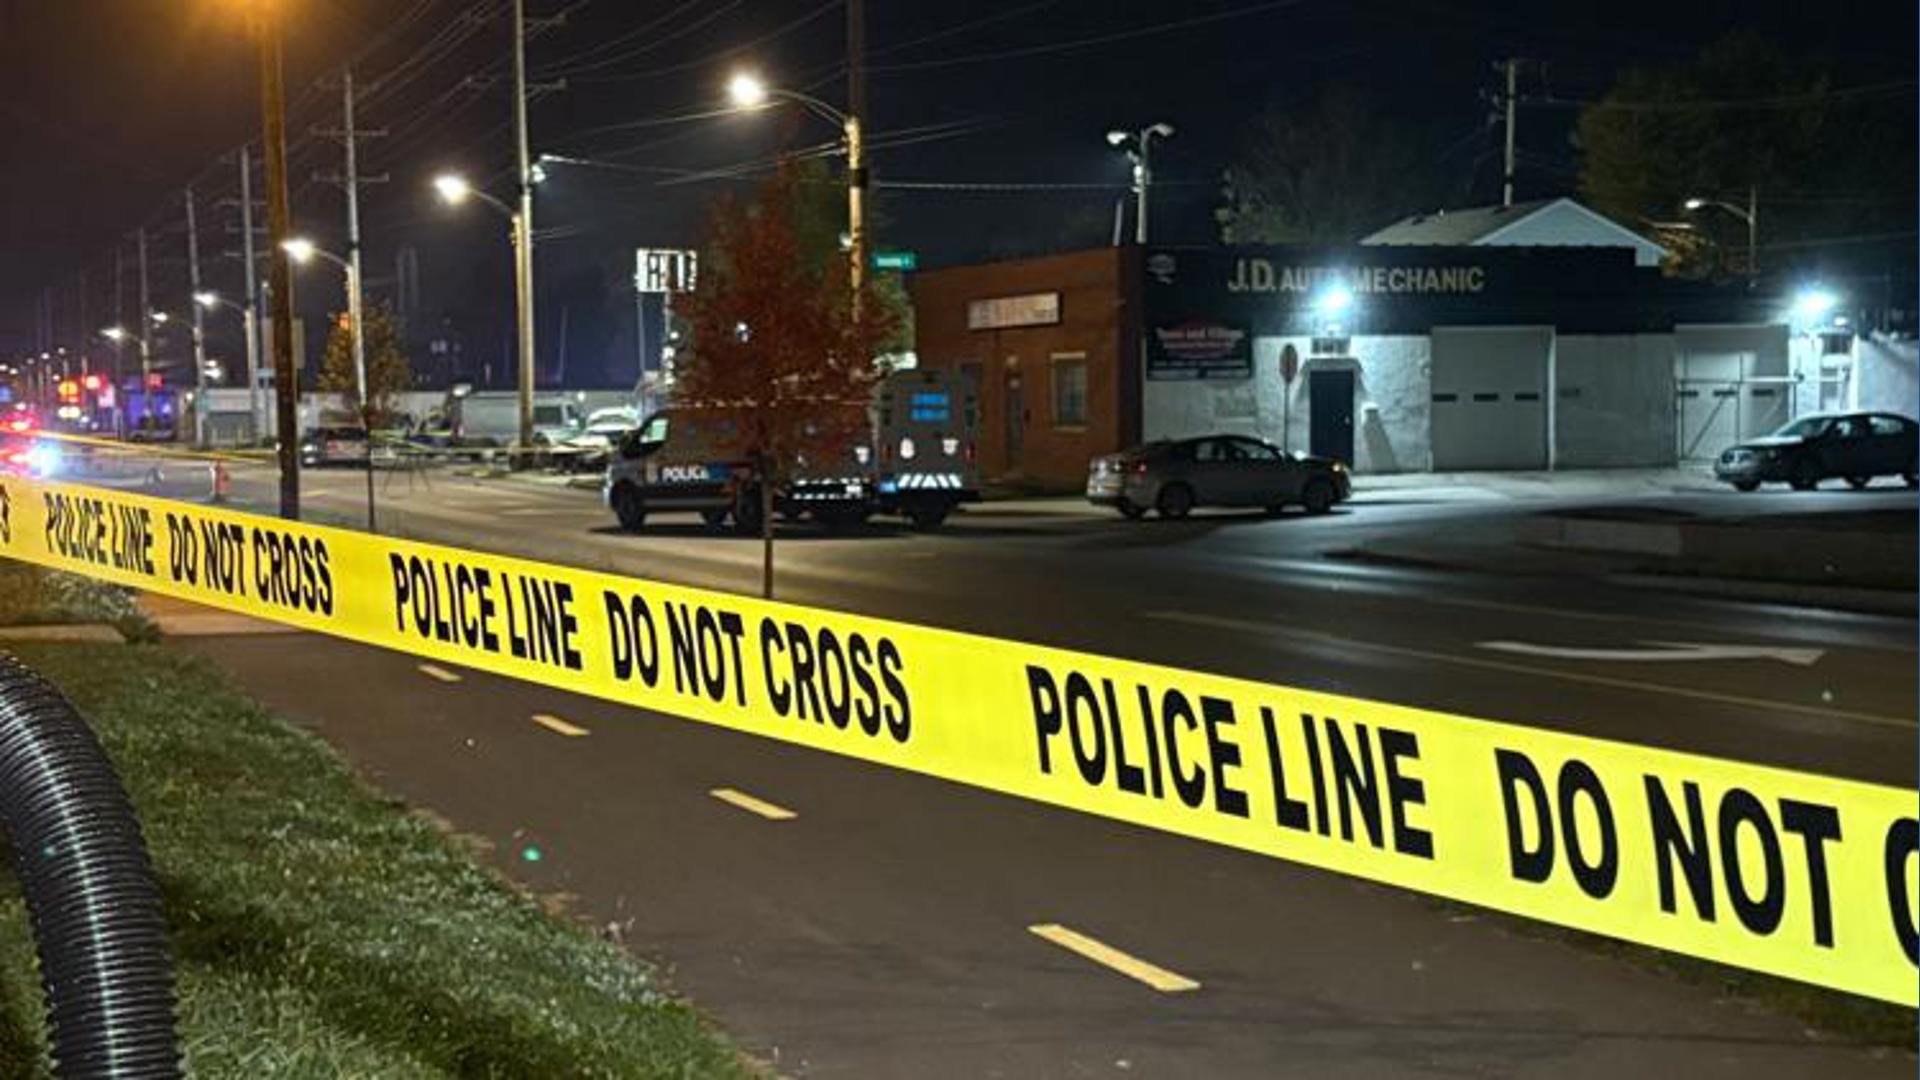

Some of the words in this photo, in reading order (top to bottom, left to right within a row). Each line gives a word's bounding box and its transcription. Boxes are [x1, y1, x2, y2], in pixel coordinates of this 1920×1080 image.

[1227, 258, 1276, 292] J.D.
[1352, 266, 1485, 293] MECHANIC
[44, 492, 107, 565] POLICE
[109, 503, 155, 576] LINE
[166, 512, 198, 586] DO
[200, 519, 246, 596] NOT
[252, 527, 333, 616] CROSS
[389, 553, 500, 653] POLICE
[501, 573, 583, 671] LINE
[603, 591, 659, 688] DO
[664, 601, 746, 707] NOT
[760, 617, 912, 743] CROSS
[1026, 665, 1250, 819] POLICE
[1260, 706, 1435, 860] LINE
[1494, 748, 1619, 900] DO
[1643, 774, 1842, 948] NOT
